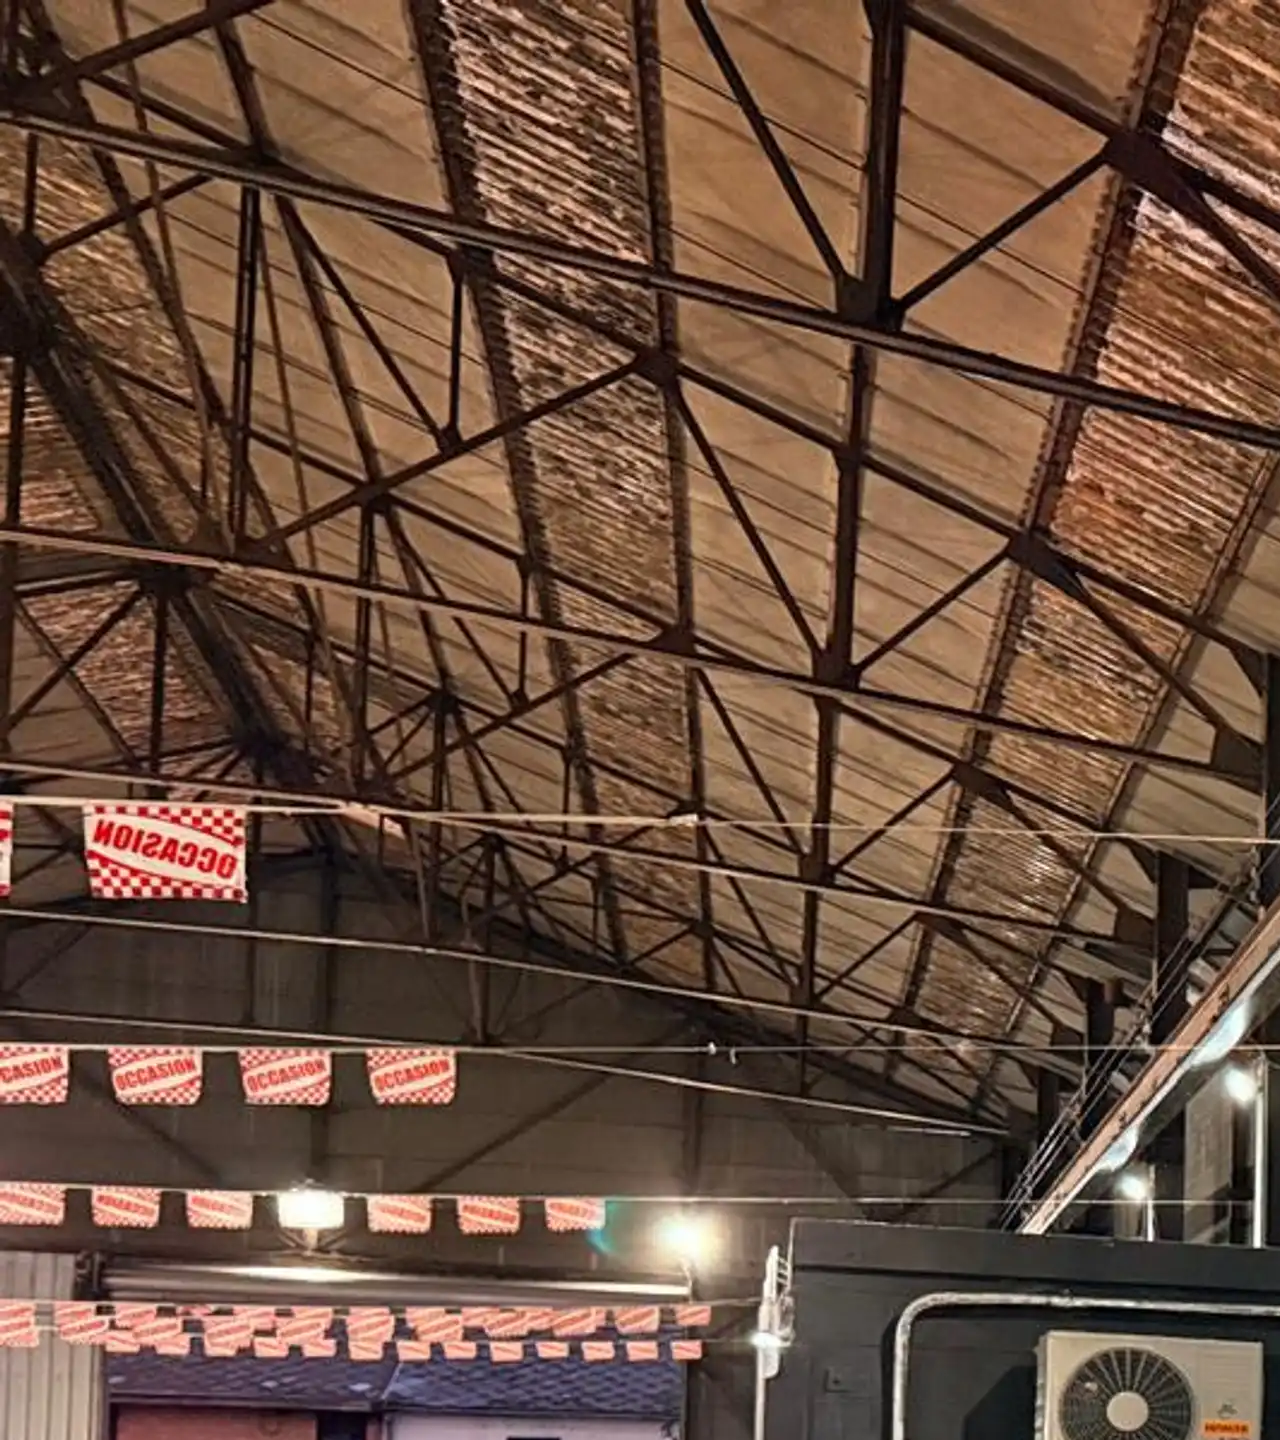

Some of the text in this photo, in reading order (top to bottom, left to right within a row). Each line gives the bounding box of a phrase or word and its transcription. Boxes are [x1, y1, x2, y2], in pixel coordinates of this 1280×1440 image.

[114, 1057, 197, 1090] OCCASION
[247, 1058, 326, 1093] OCCASION
[373, 1058, 450, 1092] OCCASION
